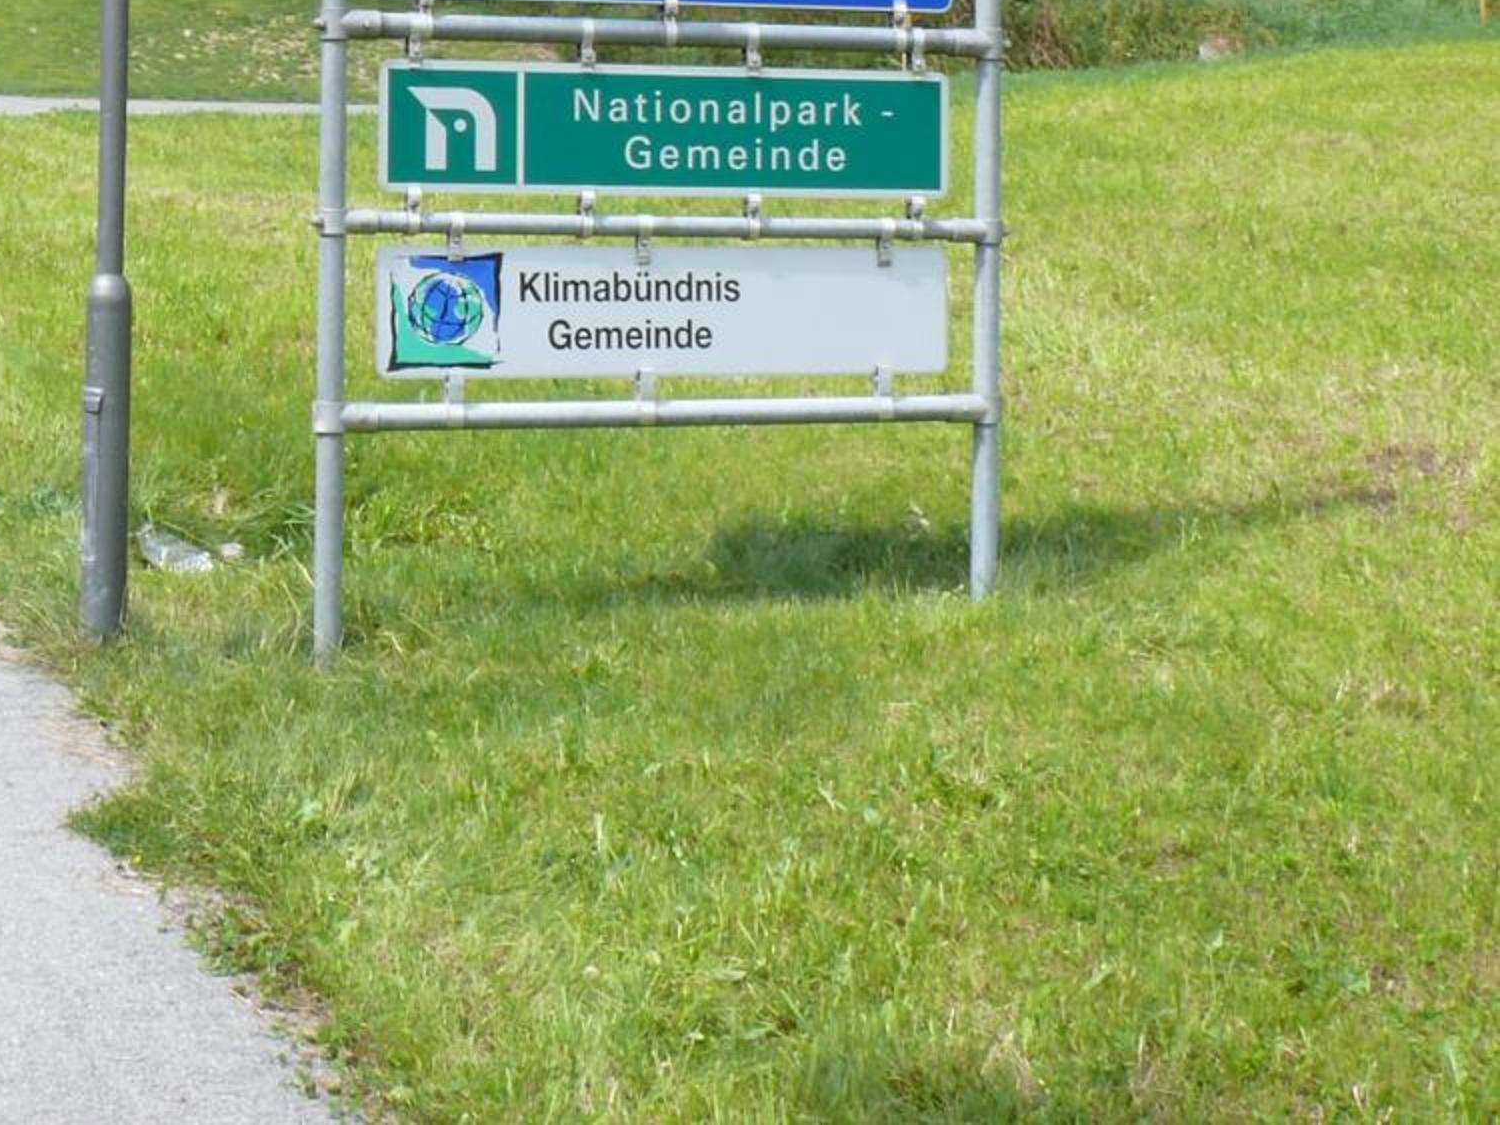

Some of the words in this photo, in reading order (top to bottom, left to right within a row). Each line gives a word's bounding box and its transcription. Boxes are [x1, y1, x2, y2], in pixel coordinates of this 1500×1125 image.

[573, 88, 862, 132] Nationalpark
[624, 135, 846, 172] Gemeinde
[519, 271, 740, 303] Klimabündnis
[548, 318, 712, 351] Gemeinde
